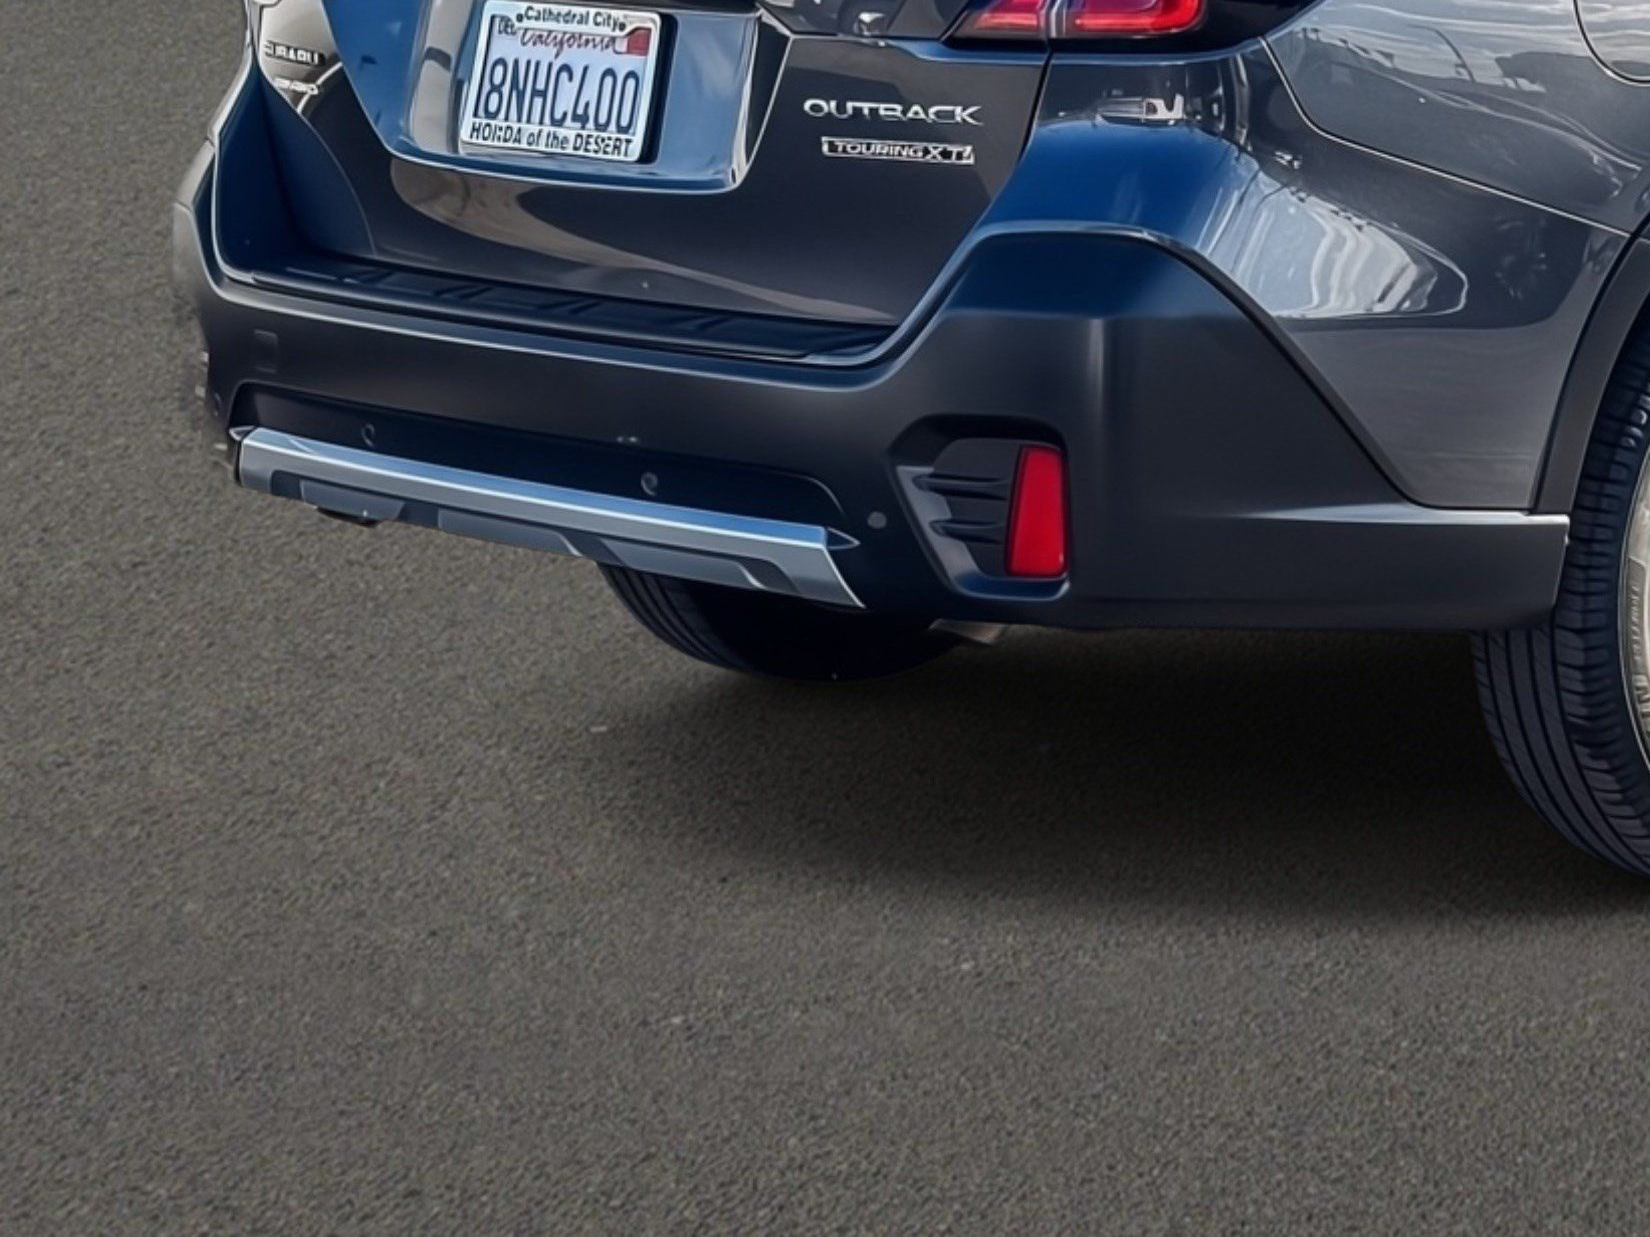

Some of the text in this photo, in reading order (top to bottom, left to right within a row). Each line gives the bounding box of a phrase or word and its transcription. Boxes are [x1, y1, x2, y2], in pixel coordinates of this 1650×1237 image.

[524, 6, 620, 32] Cathedral City
[521, 28, 616, 60] California
[483, 56, 641, 135] 8NHC400
[803, 98, 984, 126] OUTBACK
[470, 121, 633, 158] HONDA of the DESERT
